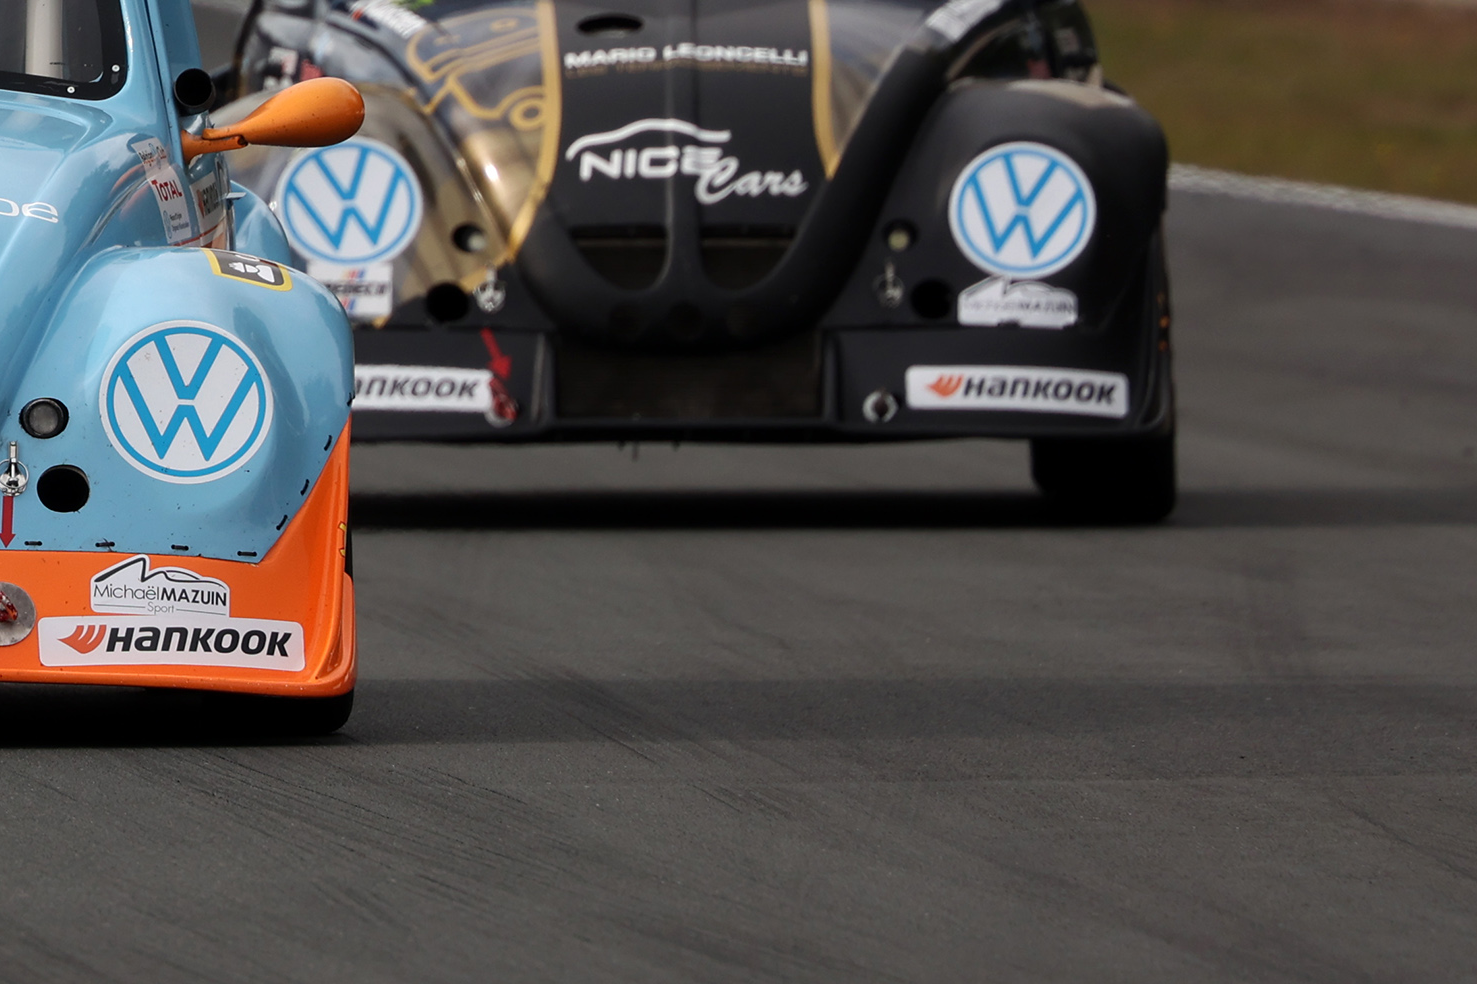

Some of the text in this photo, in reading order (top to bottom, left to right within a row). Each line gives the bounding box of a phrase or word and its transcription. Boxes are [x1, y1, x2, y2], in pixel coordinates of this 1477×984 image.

[564, 46, 657, 69] MARIO
[579, 145, 723, 182] NICE
[151, 179, 183, 203] TOTAL
[695, 156, 810, 205] Cars
[146, 602, 175, 616] Sport
